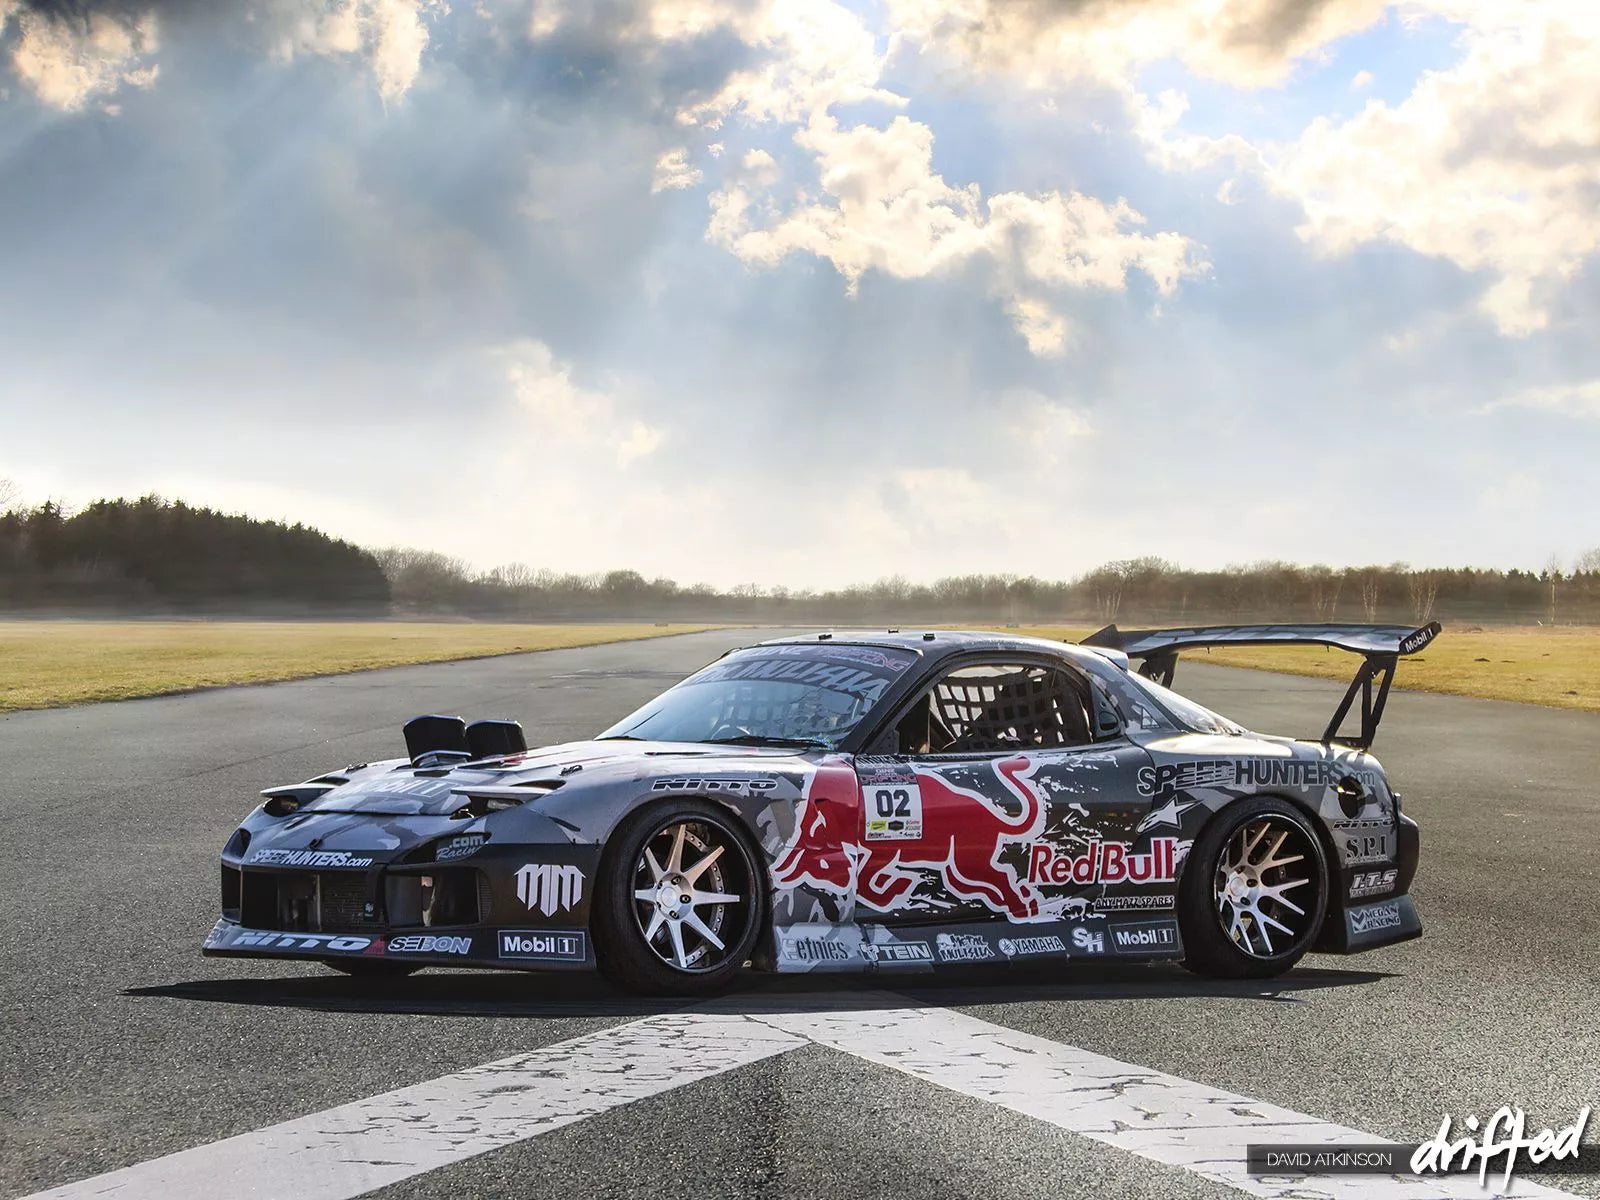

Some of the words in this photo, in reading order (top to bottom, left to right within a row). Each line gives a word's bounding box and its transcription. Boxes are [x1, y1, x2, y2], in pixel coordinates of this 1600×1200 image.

[1405, 632, 1428, 653] Mobil
[652, 777, 778, 792] NITTO
[876, 789, 911, 818] 02
[1027, 839, 1099, 884] Red
[1098, 837, 1176, 884] Bull
[1367, 915, 1400, 929] RACING
[231, 932, 371, 951] NITTO
[388, 936, 472, 954] SEIBON
[504, 936, 555, 953] Mobil
[558, 938, 574, 953] 1
[1012, 936, 1066, 954] YAMAHA
[1116, 930, 1157, 946] Mobil
[1159, 929, 1172, 943] 1
[796, 936, 850, 963] etnies
[884, 944, 932, 960] TEIN
